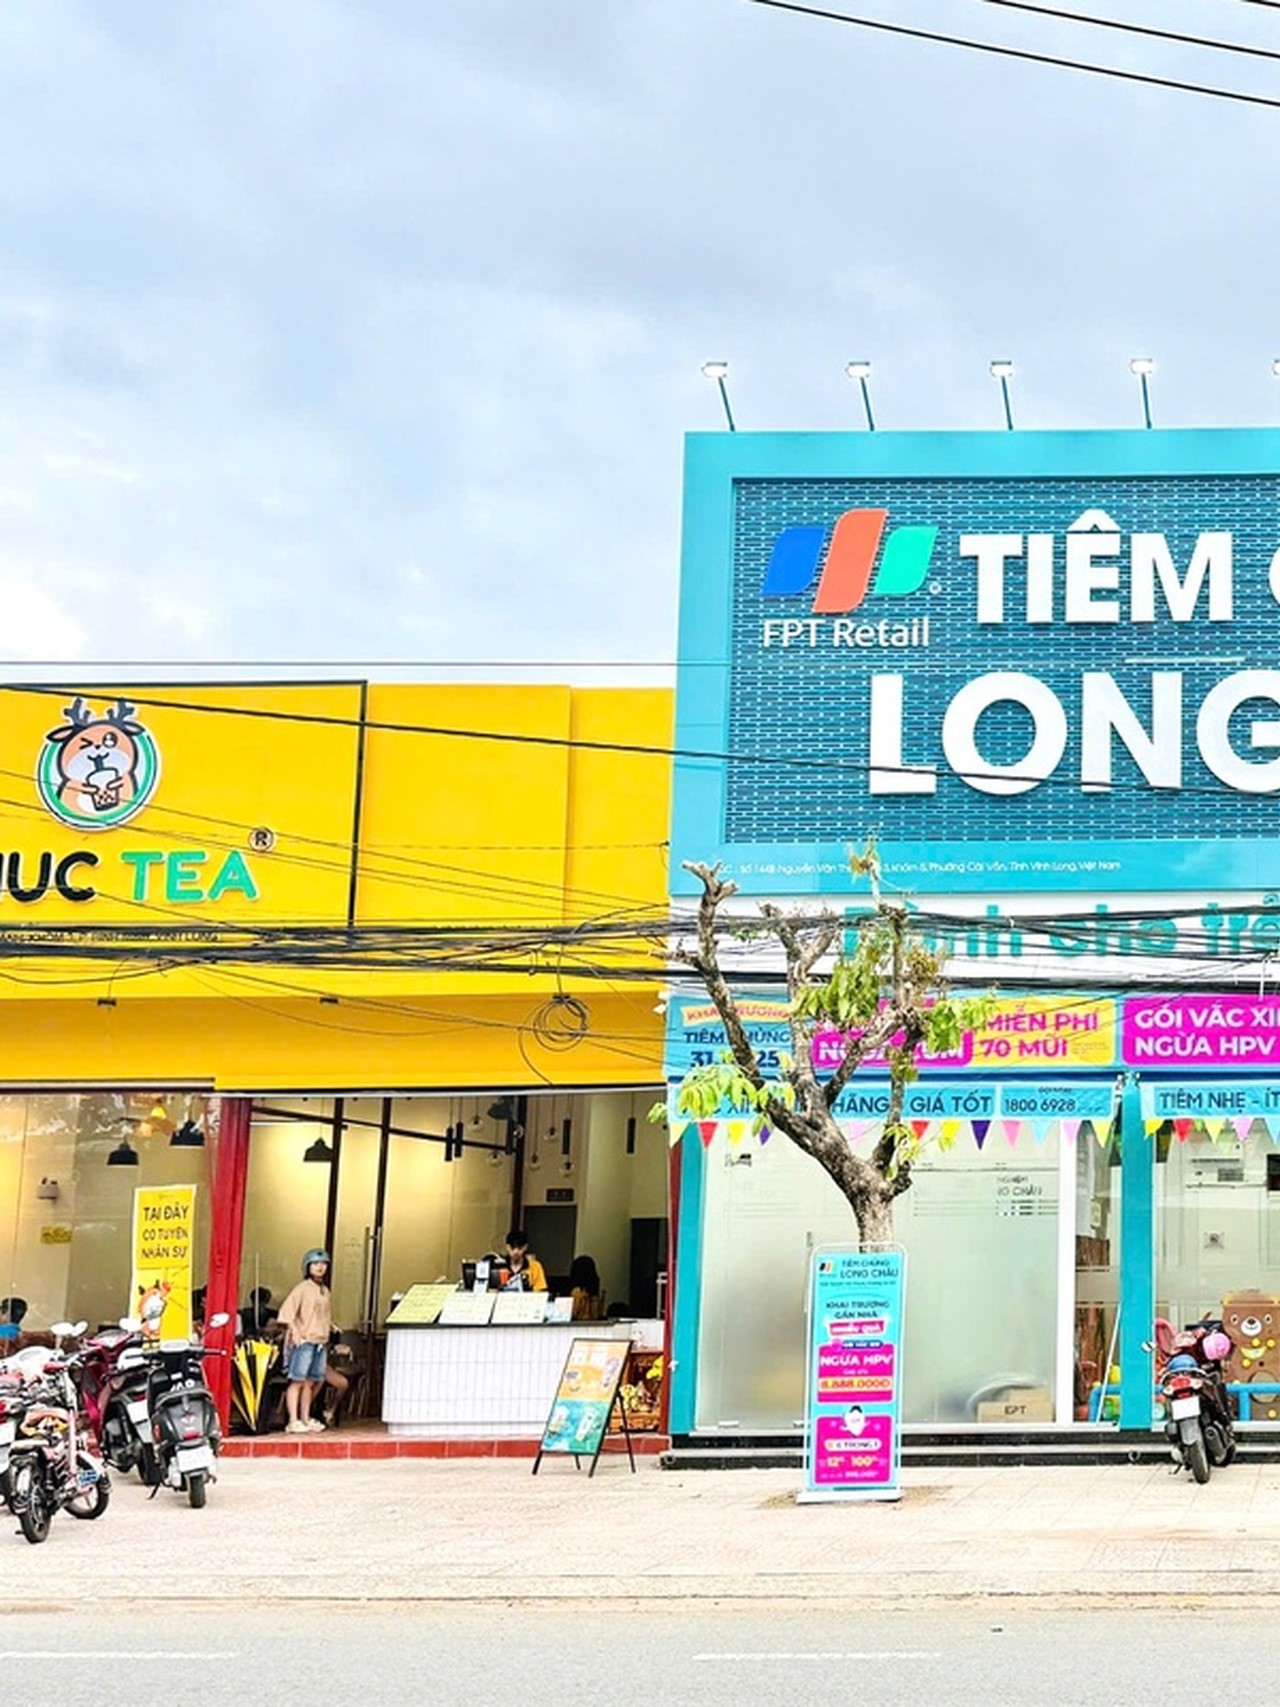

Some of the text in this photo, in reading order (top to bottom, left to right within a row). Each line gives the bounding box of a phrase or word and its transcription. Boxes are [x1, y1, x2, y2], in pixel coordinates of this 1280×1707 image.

[959, 509, 1233, 624] TIÊM
[763, 618, 930, 648] FPT Retail
[0, 850, 258, 902] UC TEA
[1055, 1007, 1098, 1031] PHÍ
[1134, 1005, 1182, 1029] GÓI
[1188, 1003, 1244, 1028] VẮC
[684, 1028, 725, 1044] TIÊM
[980, 1038, 1011, 1057] 70
[1019, 1033, 1067, 1057] MŨI
[1135, 1031, 1212, 1056] NGỪA
[1219, 1036, 1276, 1056] HPV
[910, 1091, 945, 1113] GIÁ
[952, 1087, 992, 1112] TỐT
[1005, 1099, 1037, 1112] 1800
[1040, 1099, 1076, 1112] 6928
[1160, 1087, 1203, 1108] TIÊM
[1207, 1091, 1246, 1112] NHẸ
[143, 1207, 162, 1223] TẠI
[871, 1267, 898, 1279] CHÂU
[820, 1353, 893, 1367] NGỪA HPV
